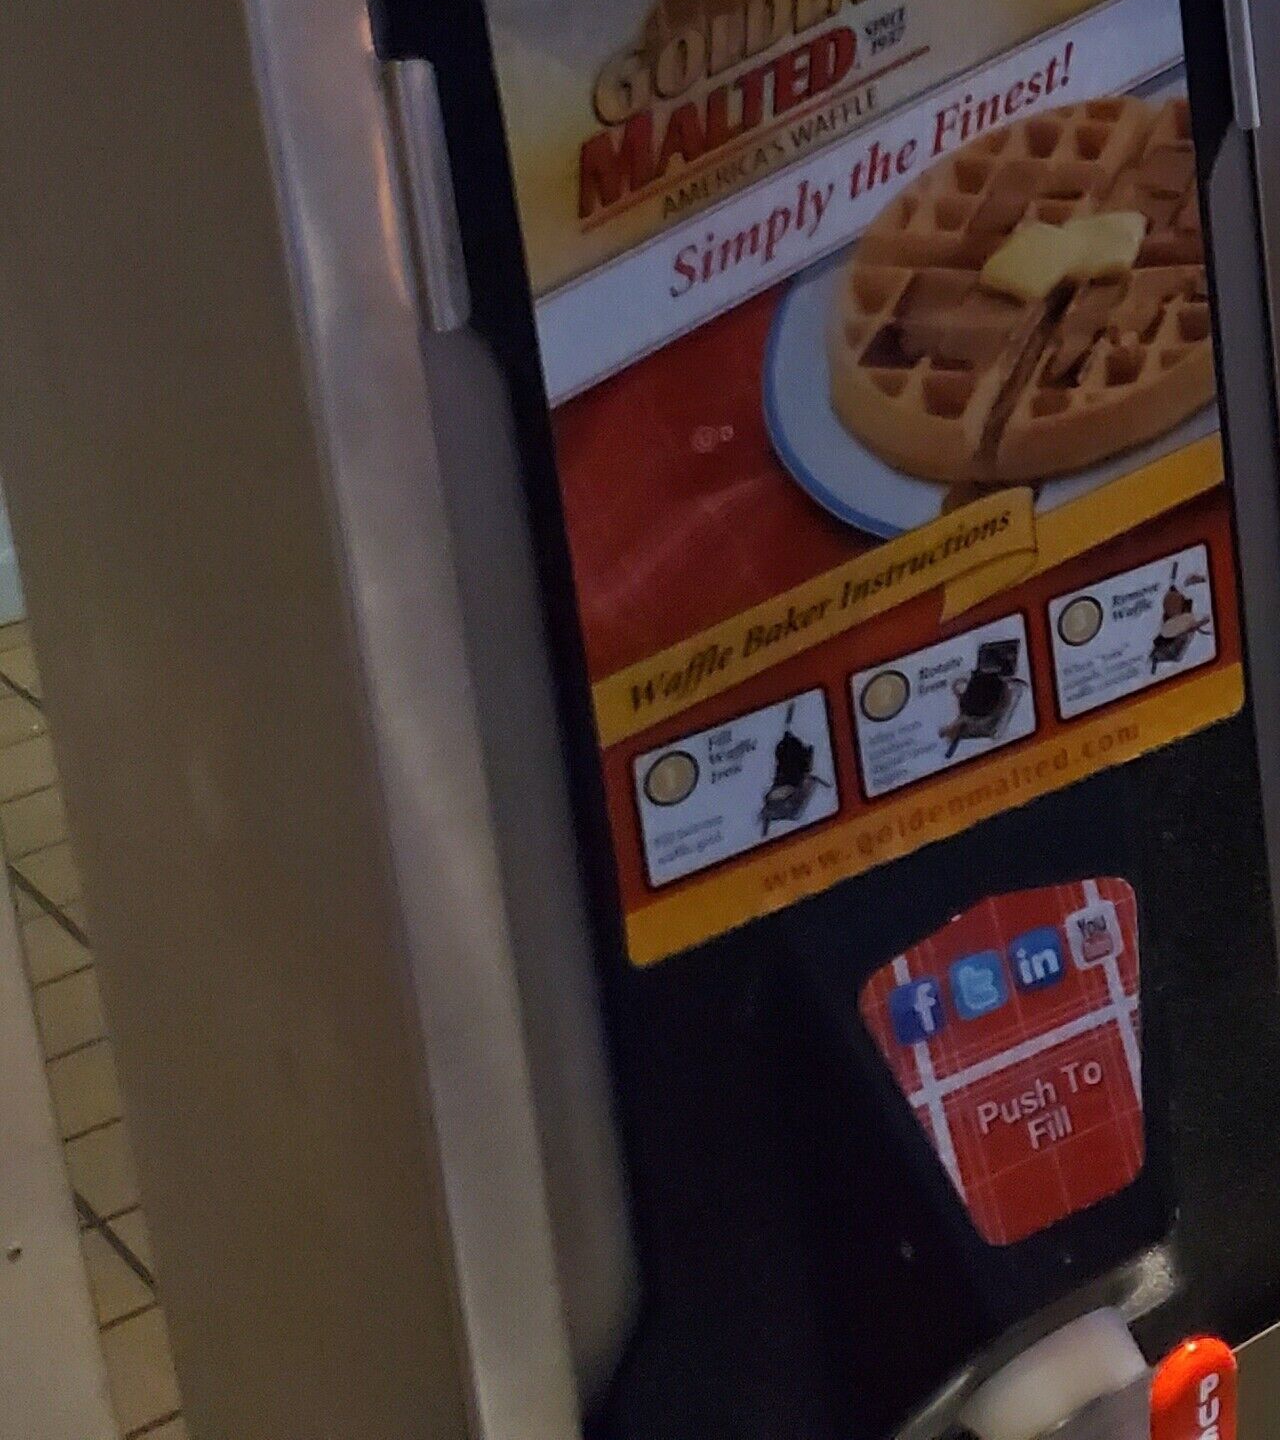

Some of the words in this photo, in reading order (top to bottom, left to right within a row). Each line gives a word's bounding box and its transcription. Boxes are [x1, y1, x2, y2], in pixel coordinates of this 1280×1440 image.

[576, 23, 860, 221] MALTED
[668, 178, 836, 300] Simply
[849, 133, 918, 202] the
[930, 40, 1076, 159] Finest!
[790, 86, 881, 161] WAFFLE
[628, 638, 734, 713] Waffle
[740, 592, 834, 661] Baker
[838, 505, 1014, 610] Instructions
[976, 1077, 1057, 1136] Push
[1062, 1060, 1104, 1099] To
[1026, 1108, 1074, 1153] Fill
